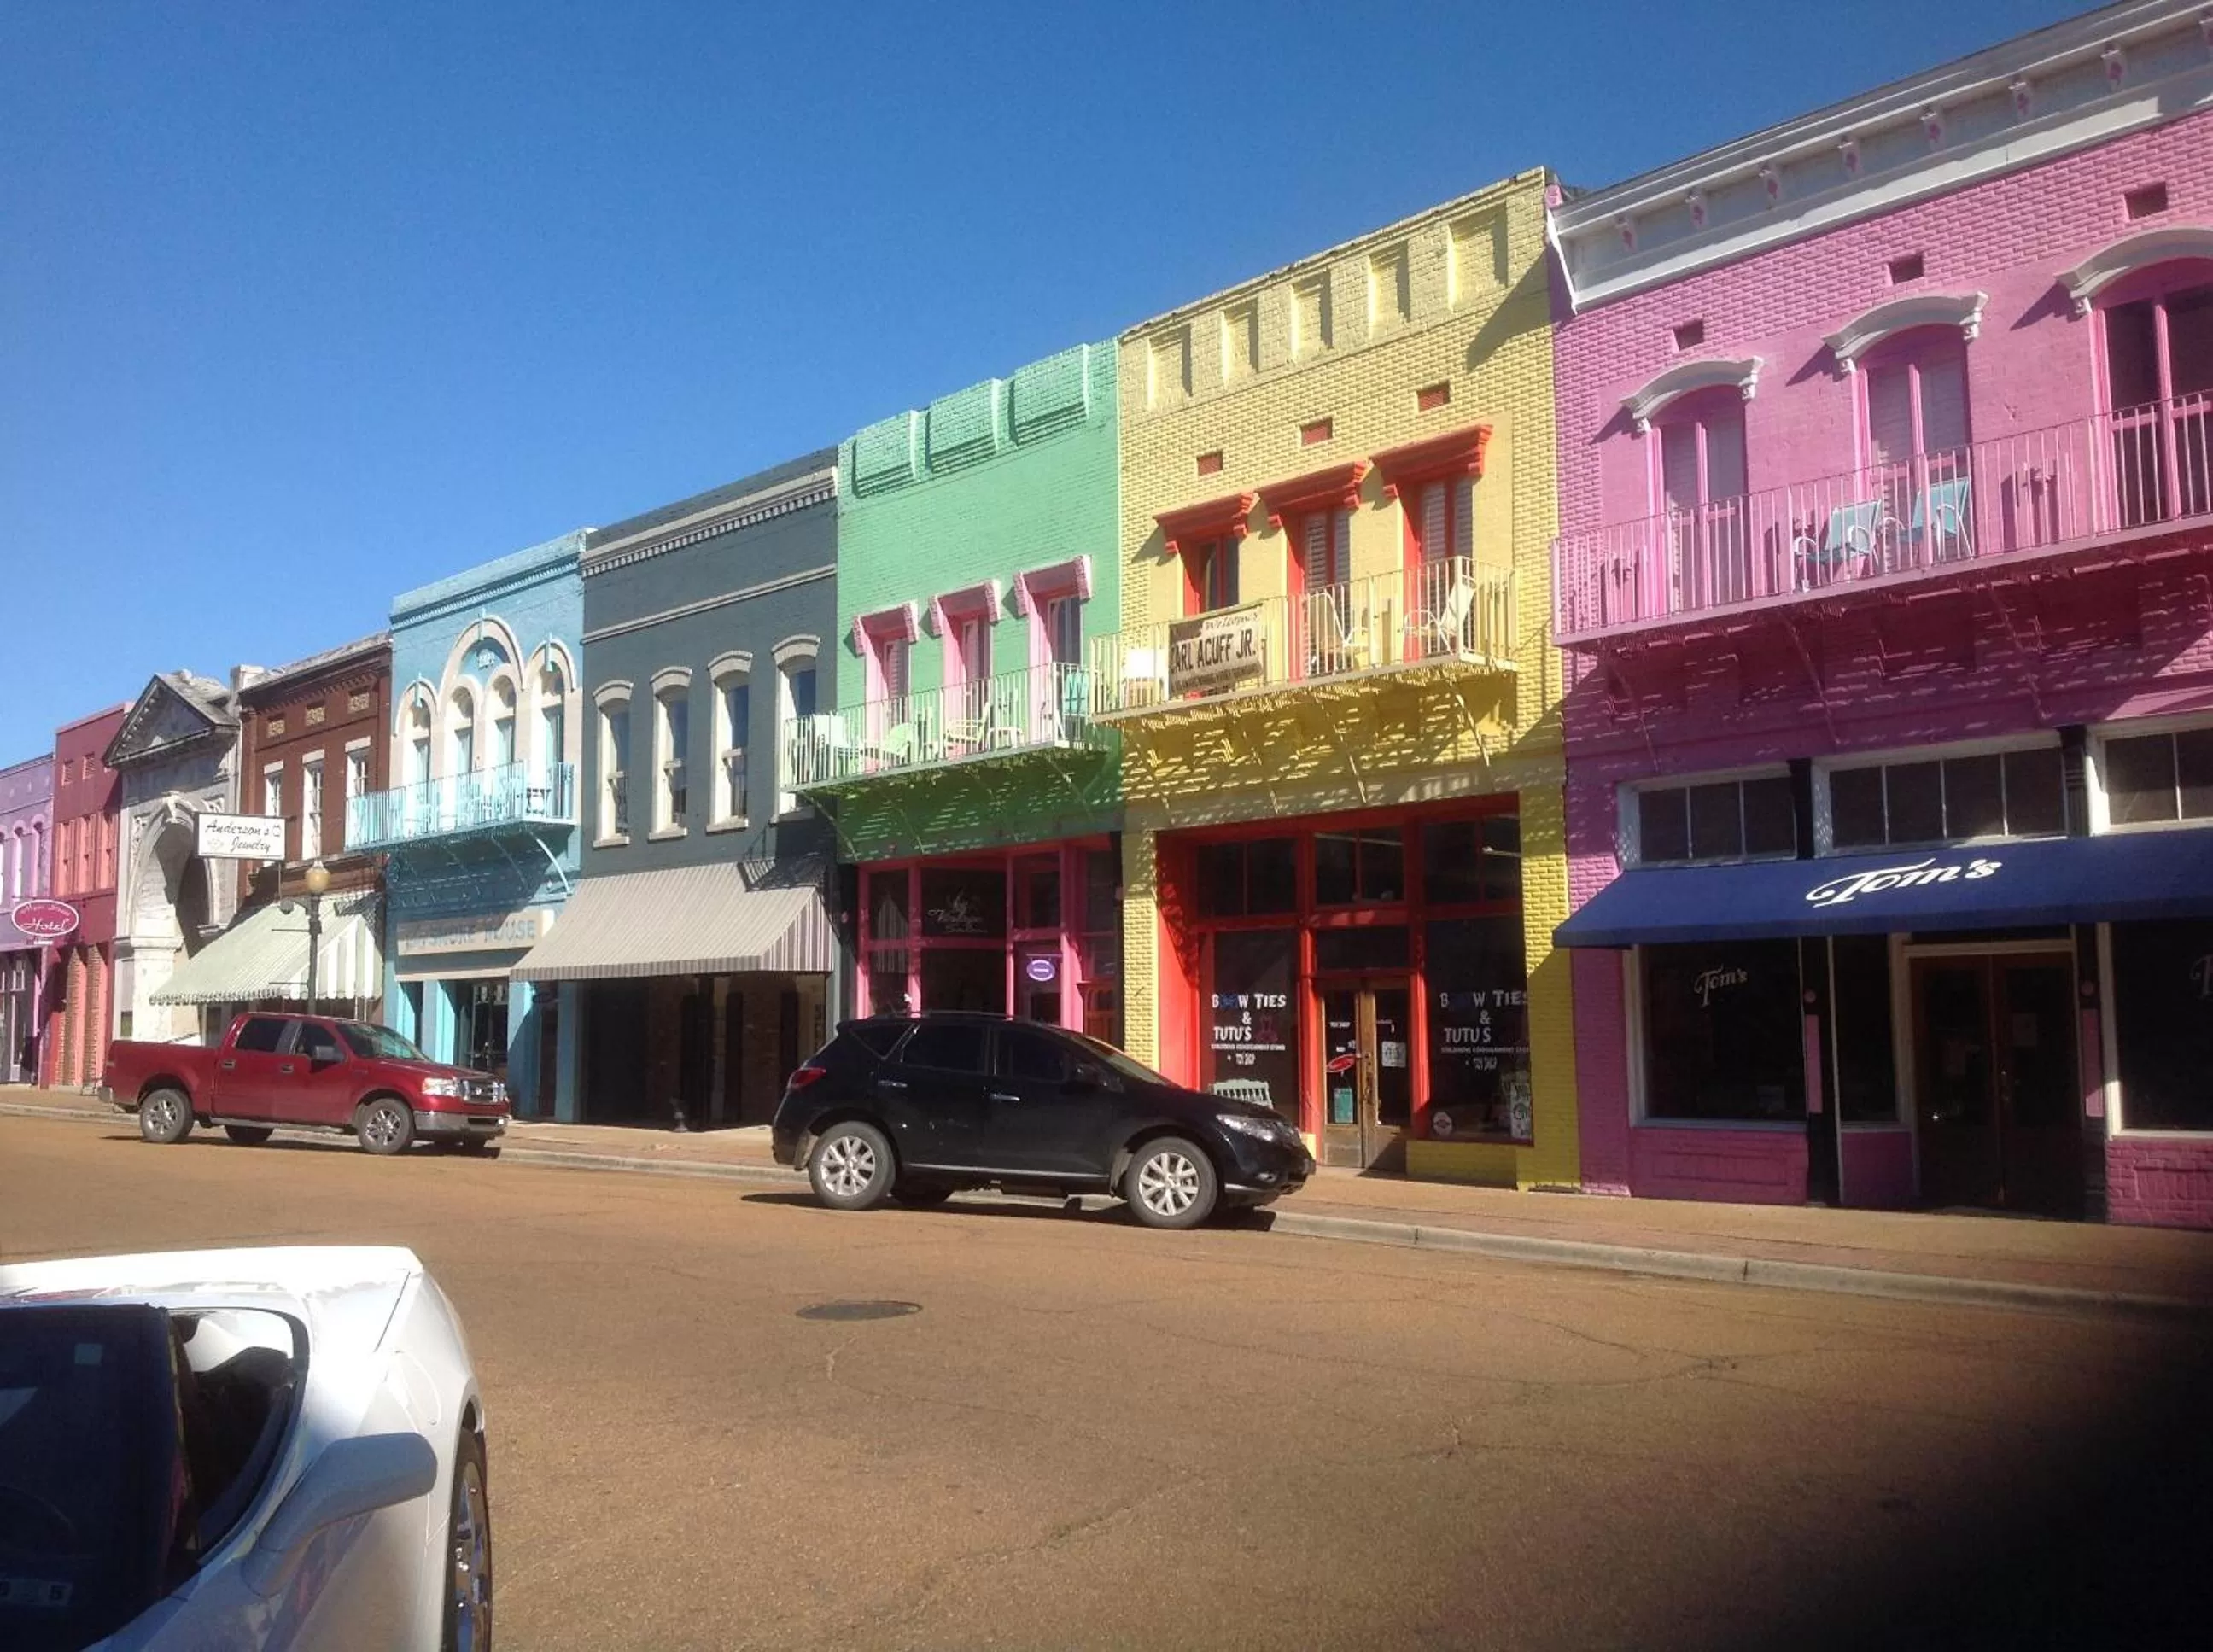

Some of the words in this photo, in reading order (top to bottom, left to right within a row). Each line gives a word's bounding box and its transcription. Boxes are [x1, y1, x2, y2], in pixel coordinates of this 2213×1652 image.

[1197, 633, 1234, 668] ACUFF
[1235, 628, 1256, 659] JR.
[230, 836, 271, 854] Jewelry
[1806, 857, 2003, 908] Tom's
[20, 917, 70, 932] Hotel
[1694, 963, 1747, 1008] Tom's
[1212, 994, 1249, 1009] BW
[1241, 1011, 1252, 1024] &
[1479, 1009, 1492, 1024] &
[1444, 1027, 1492, 1043] TUTUS
